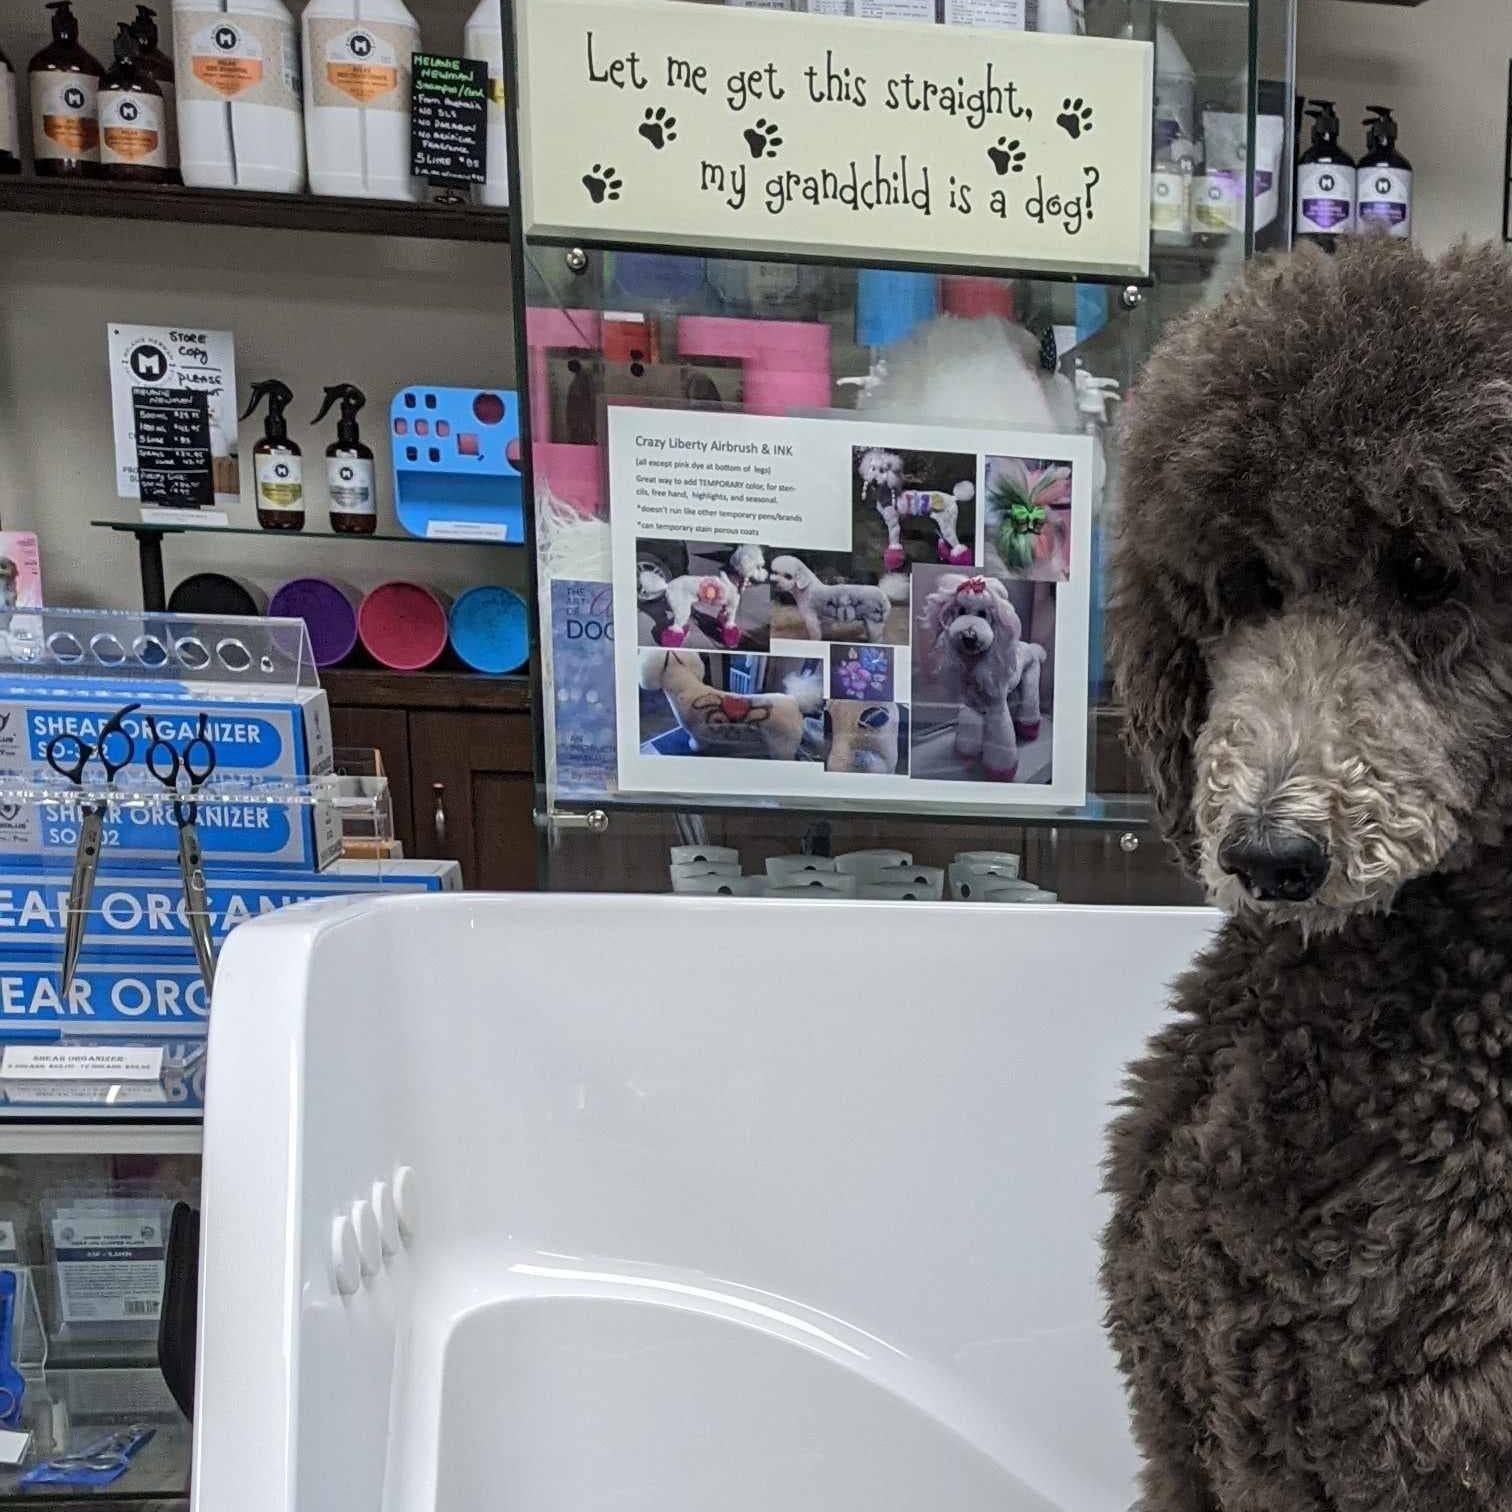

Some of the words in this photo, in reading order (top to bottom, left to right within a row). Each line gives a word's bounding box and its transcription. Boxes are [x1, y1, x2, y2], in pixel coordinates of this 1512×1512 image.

[586, 31, 648, 90] Let
[667, 56, 707, 95] me
[726, 63, 785, 111] get
[803, 50, 867, 107] this
[885, 63, 1033, 129] straight,
[700, 160, 746, 210] my
[765, 154, 931, 214] grandchild
[949, 175, 972, 214] is
[989, 189, 1007, 218] a
[1025, 165, 1100, 235] dog?
[636, 435, 666, 450] Crazy
[669, 438, 708, 453] Liberty
[711, 440, 758, 454] Airbrush
[761, 443, 770, 455] &
[773, 444, 793, 456] INK
[649, 460, 673, 468] except
[674, 460, 690, 469] pink
[691, 461, 705, 469] dye
[706, 462, 714, 470] at
[714, 463, 742, 472] bottom
[636, 474, 656, 483] Great
[658, 478, 672, 486] way
[674, 477, 682, 485] to
[684, 478, 697, 486] add
[699, 478, 744, 489] TEMPORARY
[766, 482, 777, 490] for
[651, 488, 667, 497] free
[731, 494, 745, 502] and
[684, 507, 696, 515] like
[719, 510, 757, 520] temporary
[656, 522, 693, 533] temporary
